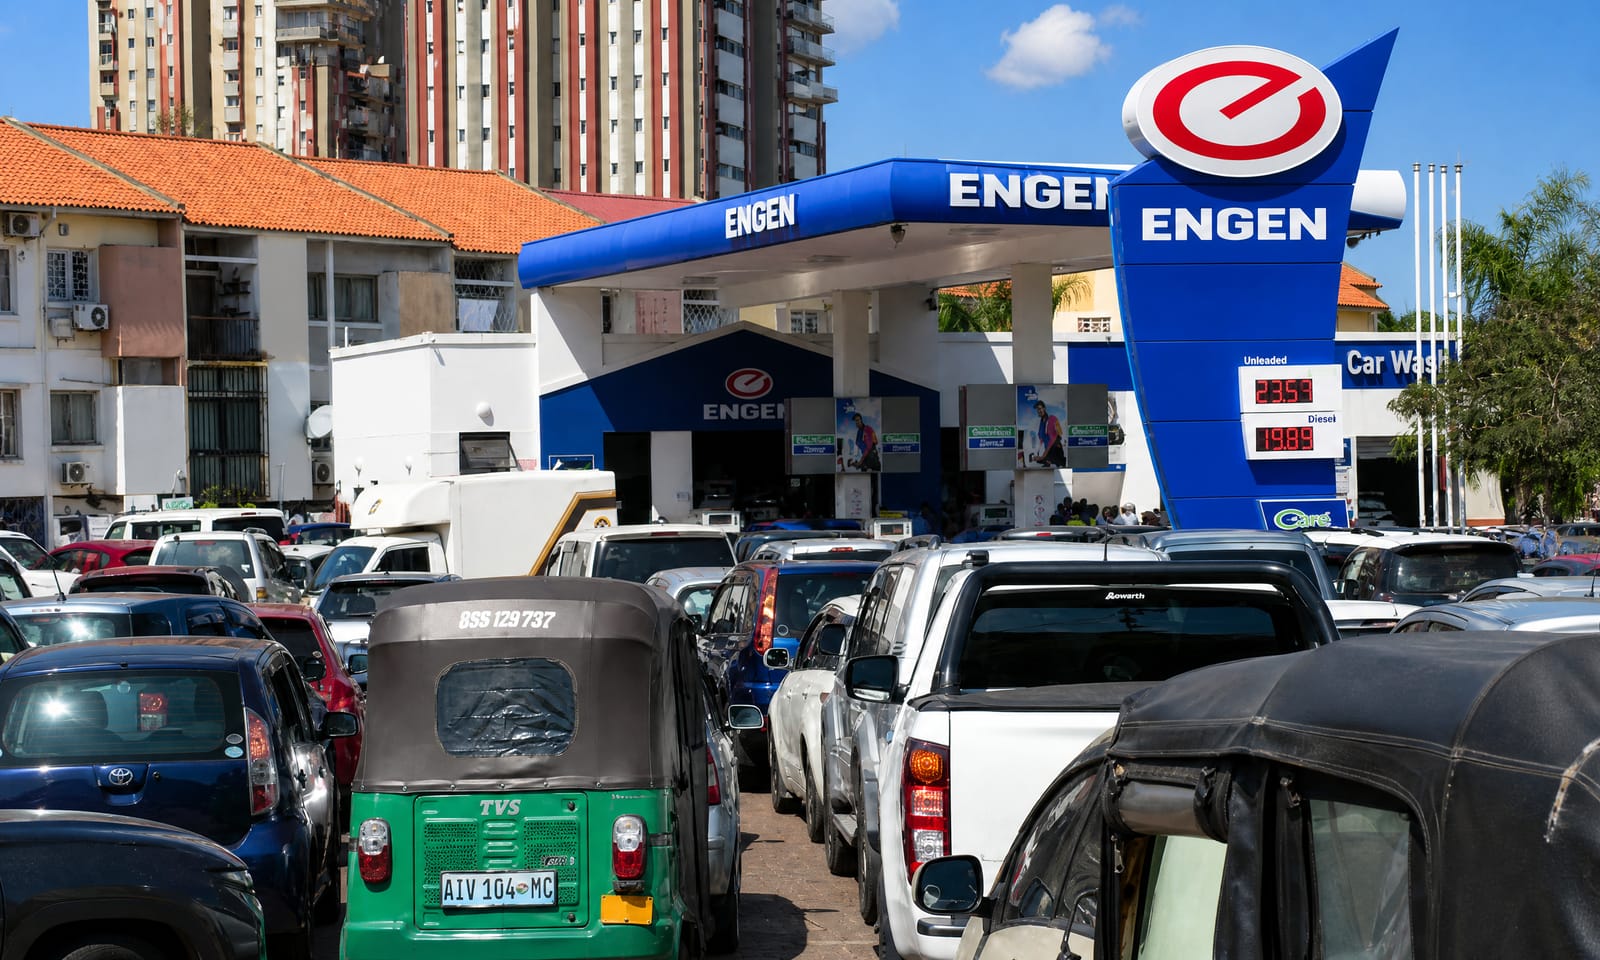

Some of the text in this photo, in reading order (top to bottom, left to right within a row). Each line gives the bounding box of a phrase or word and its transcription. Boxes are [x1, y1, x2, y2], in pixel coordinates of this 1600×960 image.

[726, 193, 795, 239] ENGEN
[1142, 207, 1327, 241] ENGEN
[1243, 356, 1288, 365] Unleaded
[1347, 350, 1384, 375] Car
[1256, 379, 1313, 403] 23.59
[1308, 415, 1336, 423] Diesel
[1265, 427, 1313, 451] 19.89
[1274, 508, 1331, 530] Care
[493, 610, 521, 628] 129
[521, 610, 557, 629] 737
[480, 799, 521, 816] TVS
[444, 876, 553, 901] AIV 104 MC
